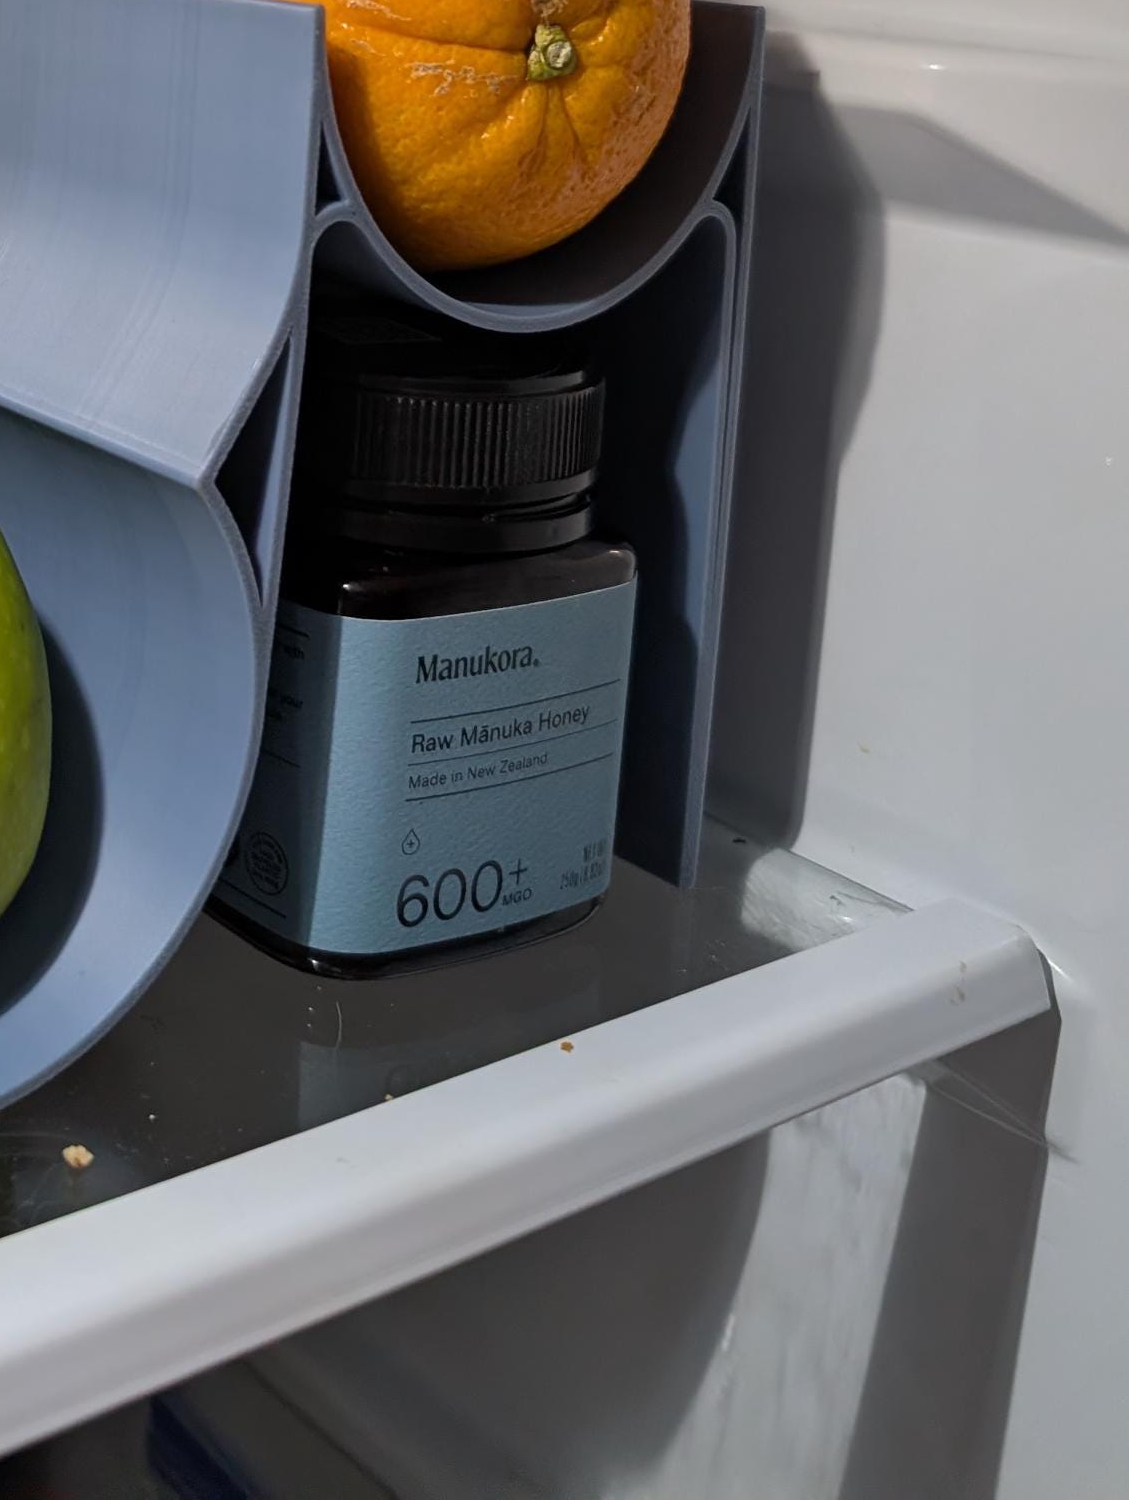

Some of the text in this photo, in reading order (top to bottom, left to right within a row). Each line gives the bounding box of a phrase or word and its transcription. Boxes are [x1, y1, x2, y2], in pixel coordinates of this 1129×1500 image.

[411, 706, 591, 753] Raw Mānuka Honey
[408, 752, 548, 789] Made in New Zealand
[502, 888, 533, 907] MGO
